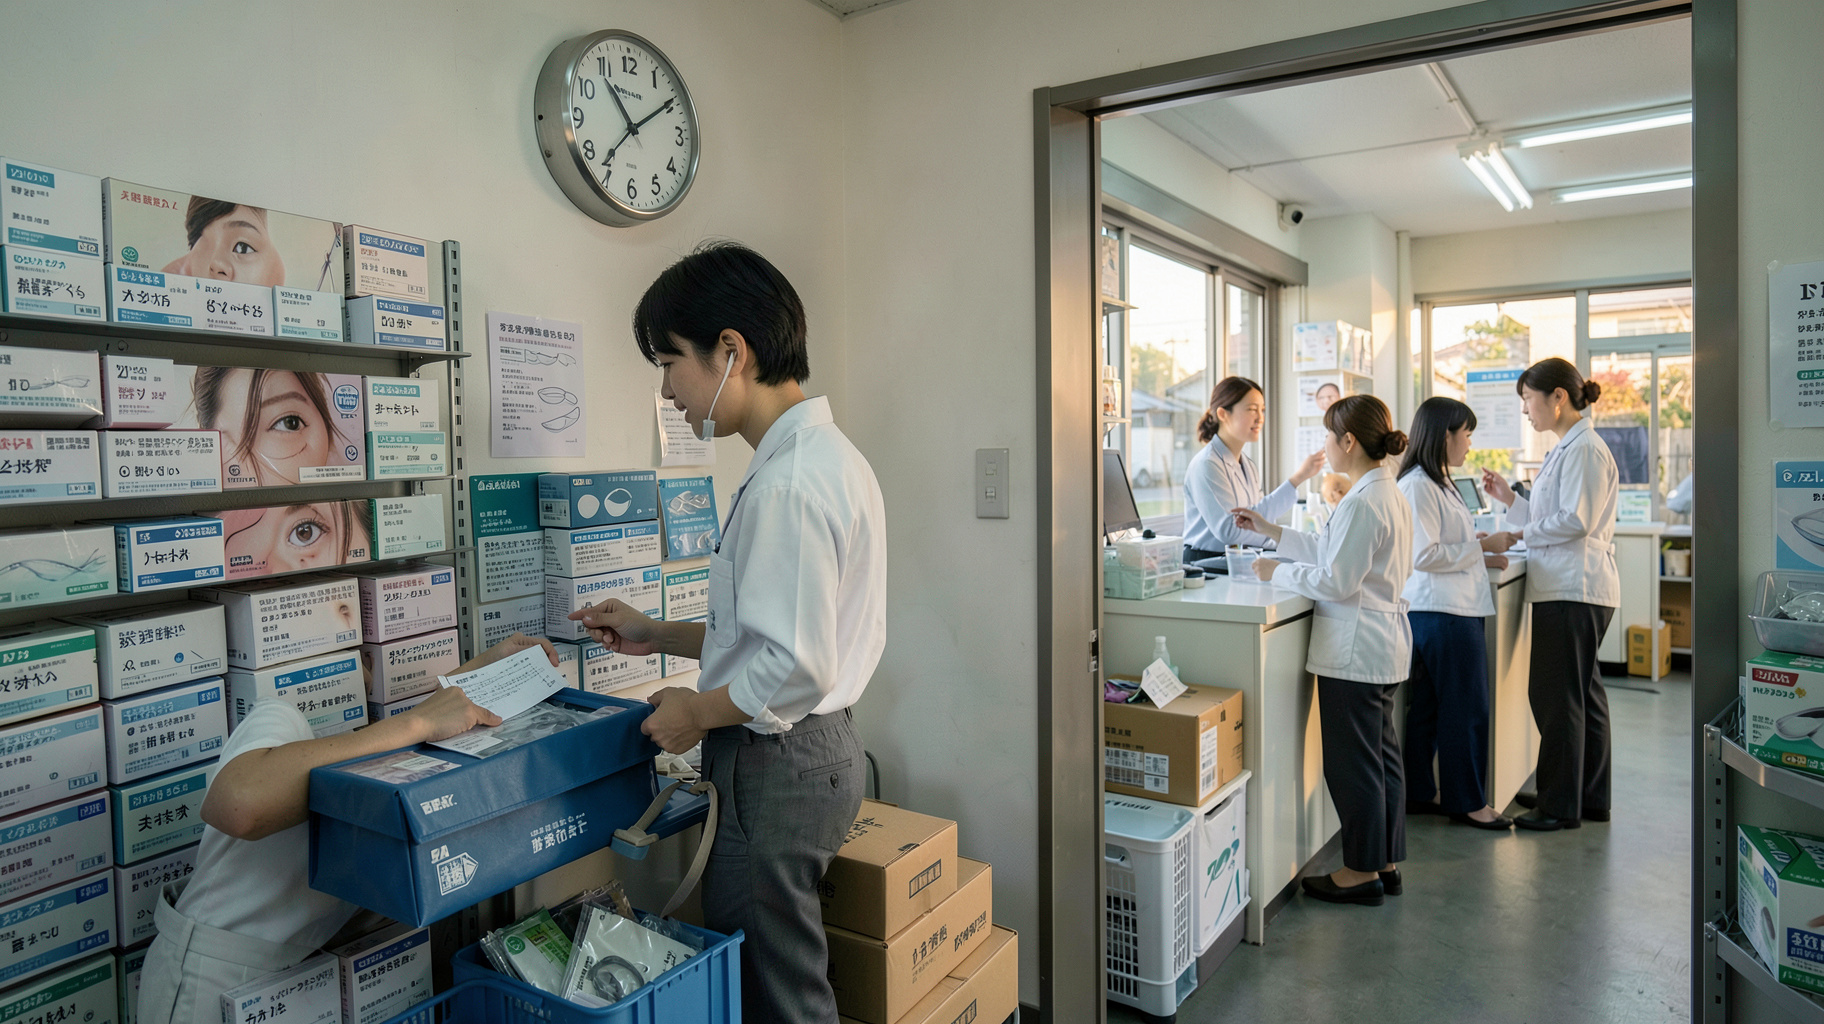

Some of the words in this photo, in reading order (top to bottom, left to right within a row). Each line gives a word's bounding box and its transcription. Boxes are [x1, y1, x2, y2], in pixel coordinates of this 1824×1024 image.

[622, 55, 638, 76] 12
[578, 75, 596, 100] 10
[650, 67, 659, 89] 1
[573, 107, 584, 129] 9
[675, 126, 684, 147] 3
[583, 139, 596, 161] 8
[666, 156, 677, 176] 4
[627, 178, 637, 200] 6
[651, 173, 661, 196] 5
